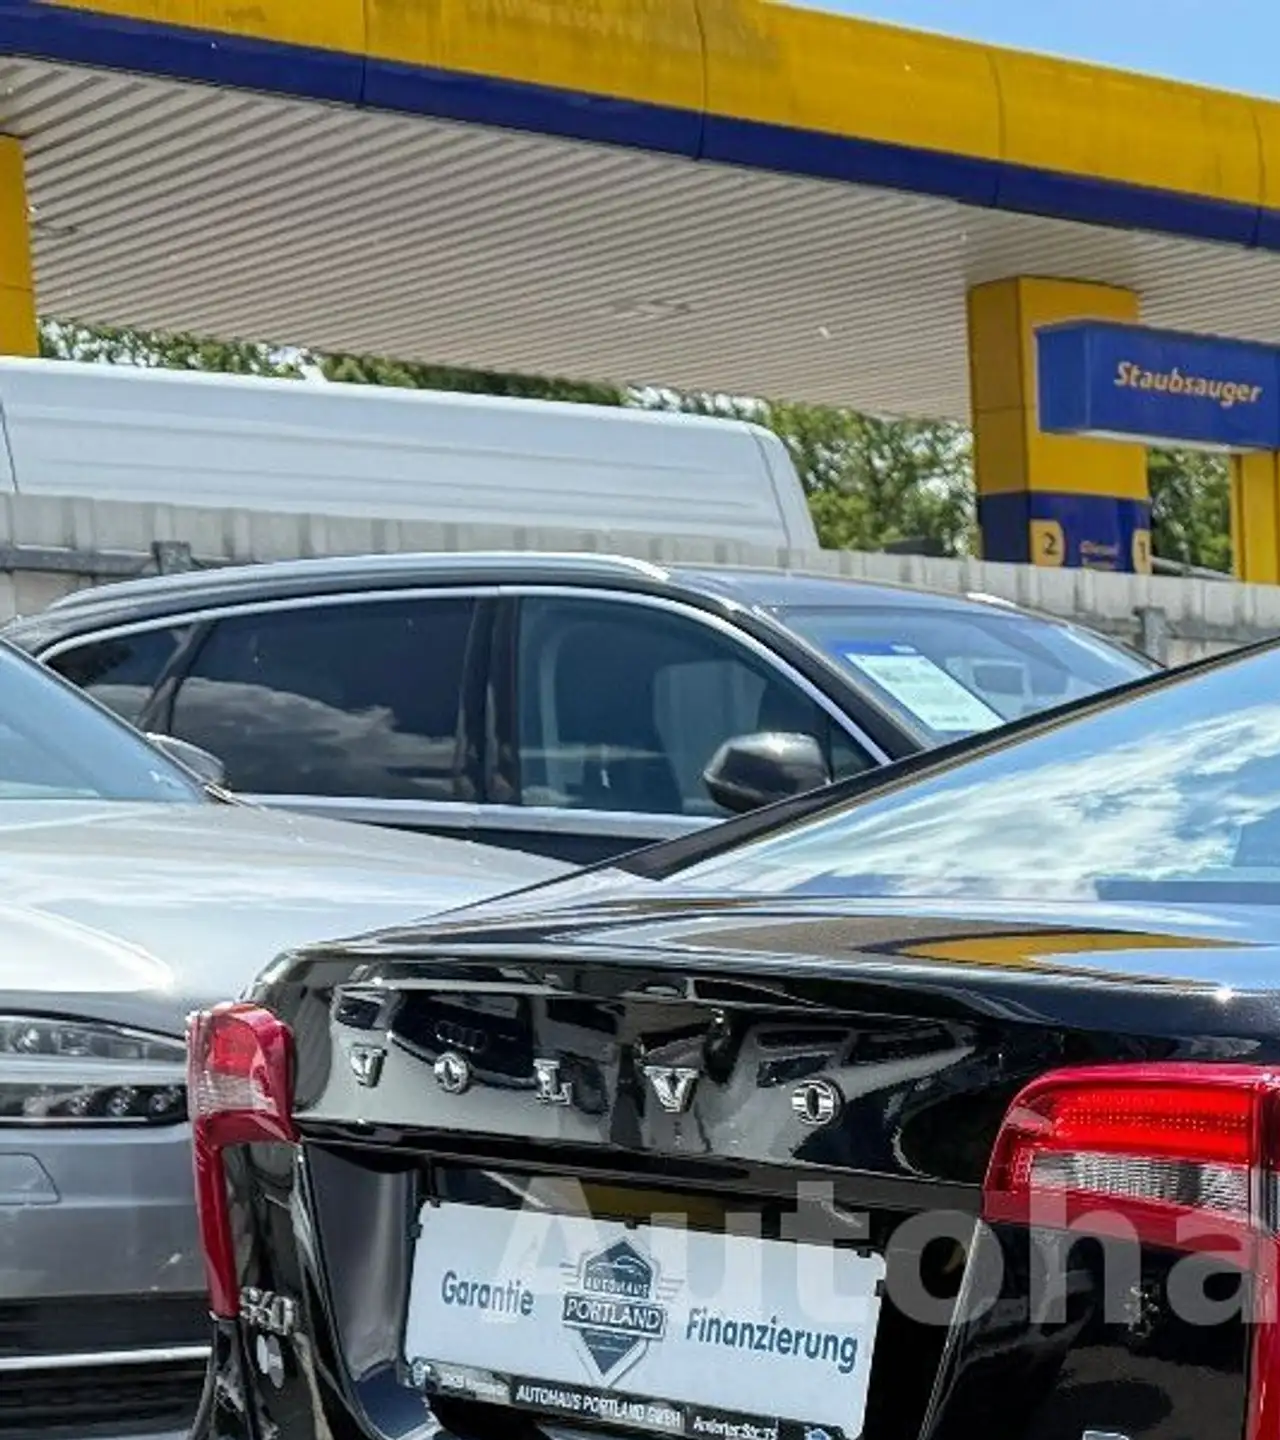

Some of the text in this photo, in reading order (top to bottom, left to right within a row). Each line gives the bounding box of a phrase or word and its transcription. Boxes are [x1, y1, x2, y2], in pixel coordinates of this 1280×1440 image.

[1113, 360, 1264, 408] Staubsauger
[1043, 531, 1058, 556] 2
[349, 1044, 843, 1126] VOLVO
[440, 1269, 536, 1317] Garantie
[565, 1297, 661, 1330] PORTLAND
[685, 1308, 858, 1374] Finanzierung
[515, 1384, 582, 1411] AUTOHAUS
[583, 1395, 645, 1420] PORTLAND
